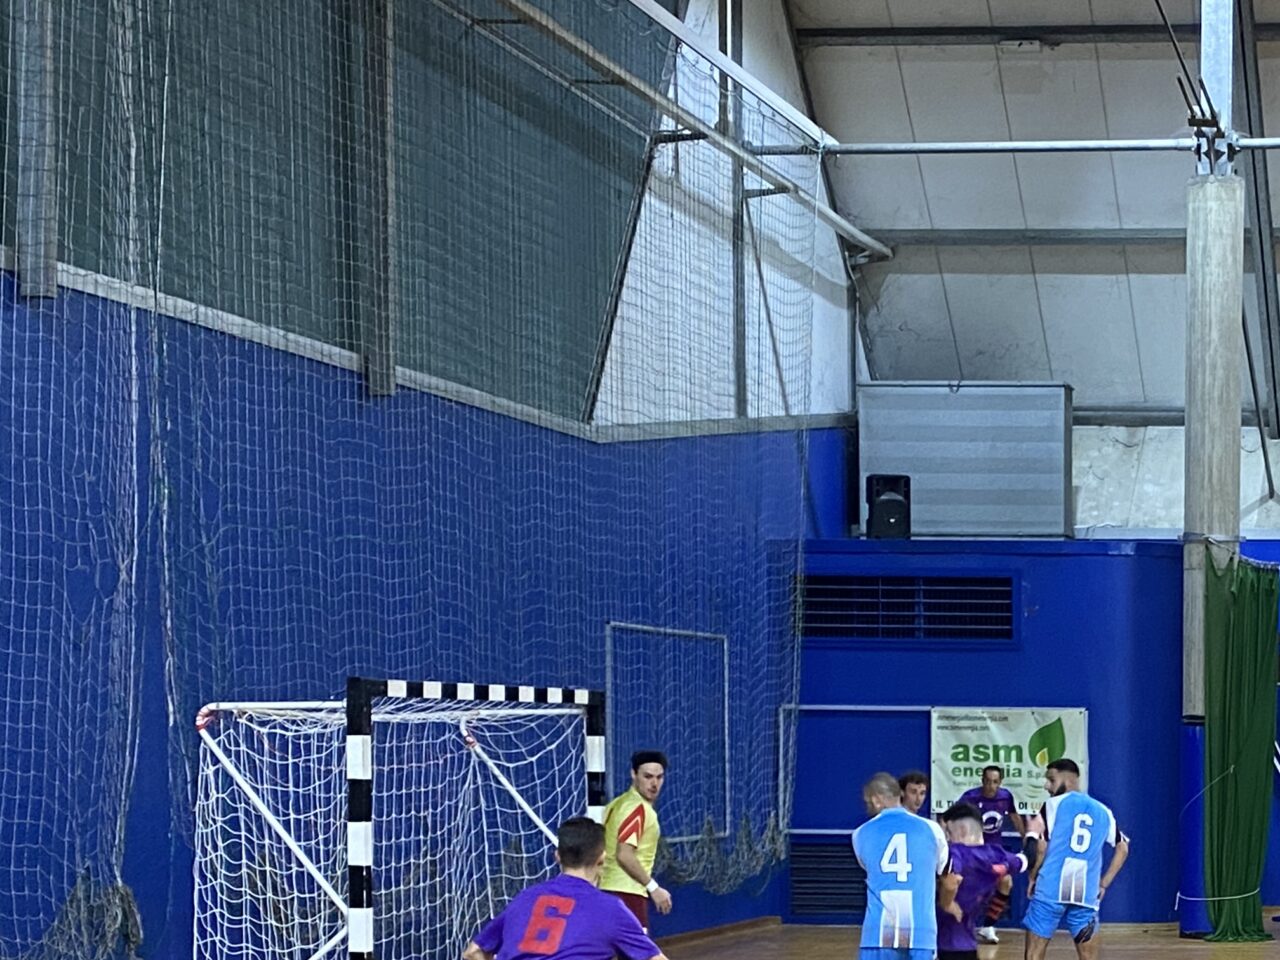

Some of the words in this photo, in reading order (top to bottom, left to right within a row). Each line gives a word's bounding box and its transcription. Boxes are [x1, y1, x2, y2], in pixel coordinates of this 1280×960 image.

[951, 743, 1023, 763] asm
[1018, 801, 1028, 810] DI
[1070, 813, 1094, 853] 6
[880, 833, 912, 882] 4
[518, 895, 576, 955] 6
